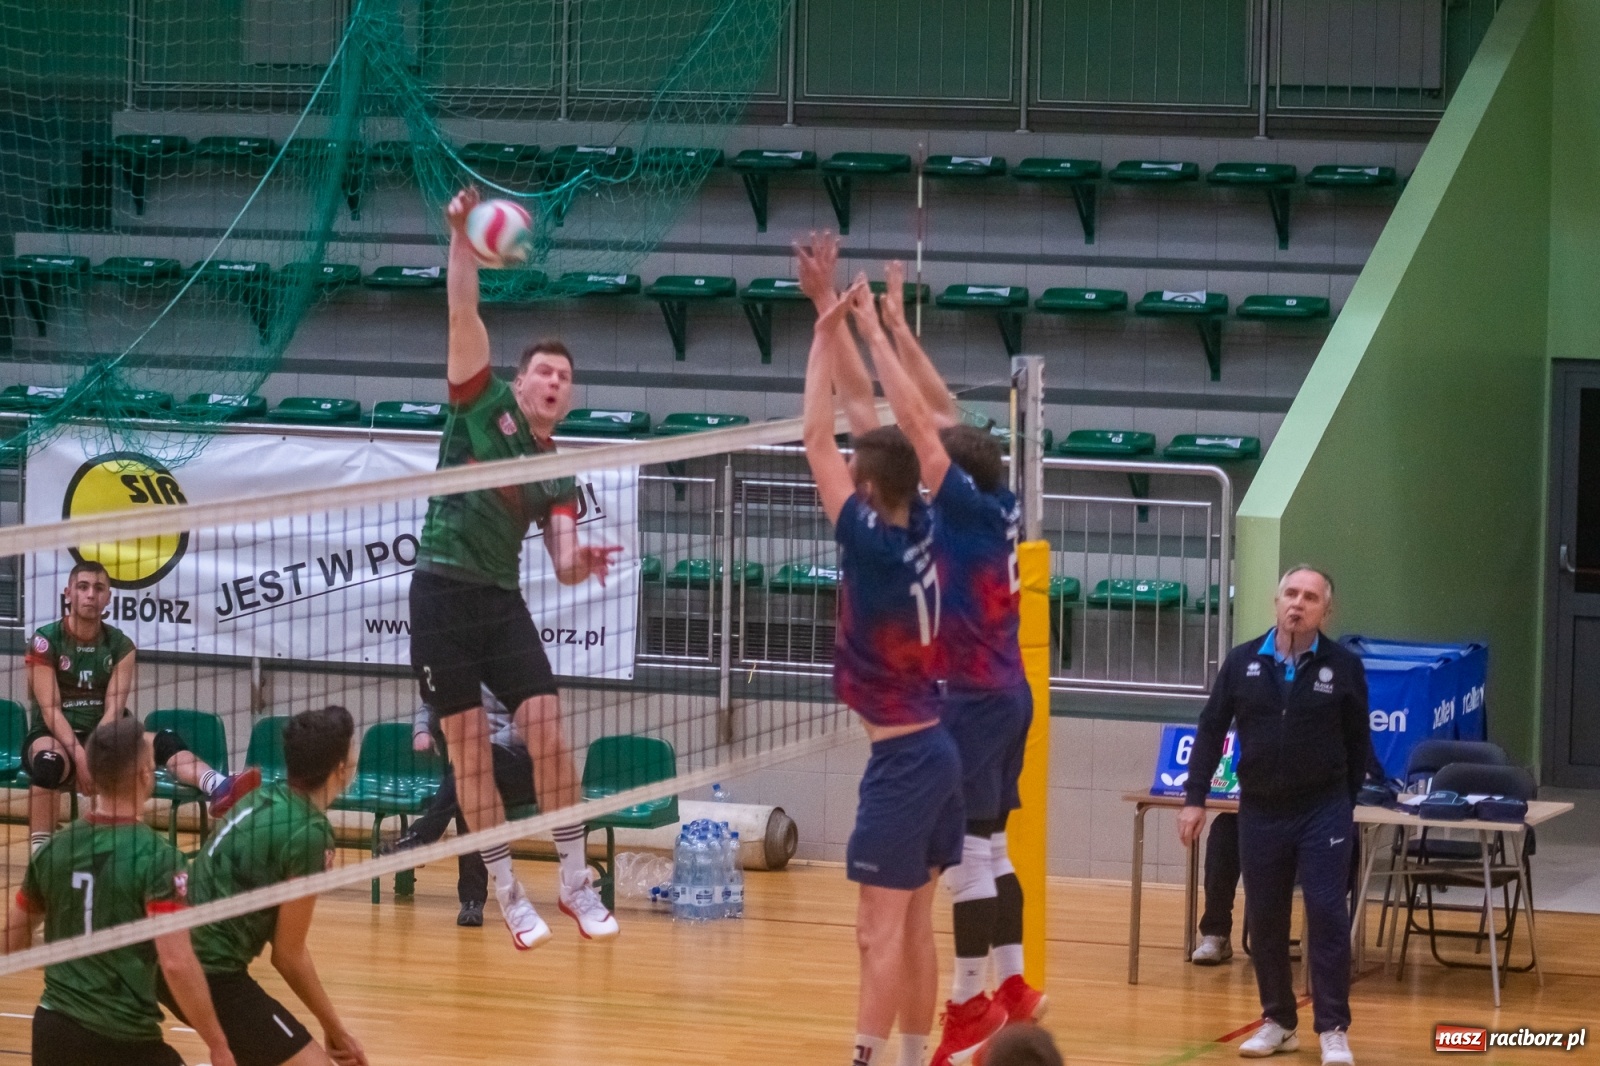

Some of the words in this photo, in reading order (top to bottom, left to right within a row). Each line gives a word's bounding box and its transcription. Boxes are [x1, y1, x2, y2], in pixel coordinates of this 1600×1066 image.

[214, 561, 307, 617] JEST
[317, 549, 354, 587] W
[909, 562, 941, 647] 17
[60, 592, 192, 625] RIBÓRZ
[423, 665, 436, 692] 2
[1175, 735, 1195, 765] 6
[71, 871, 94, 939] 7
